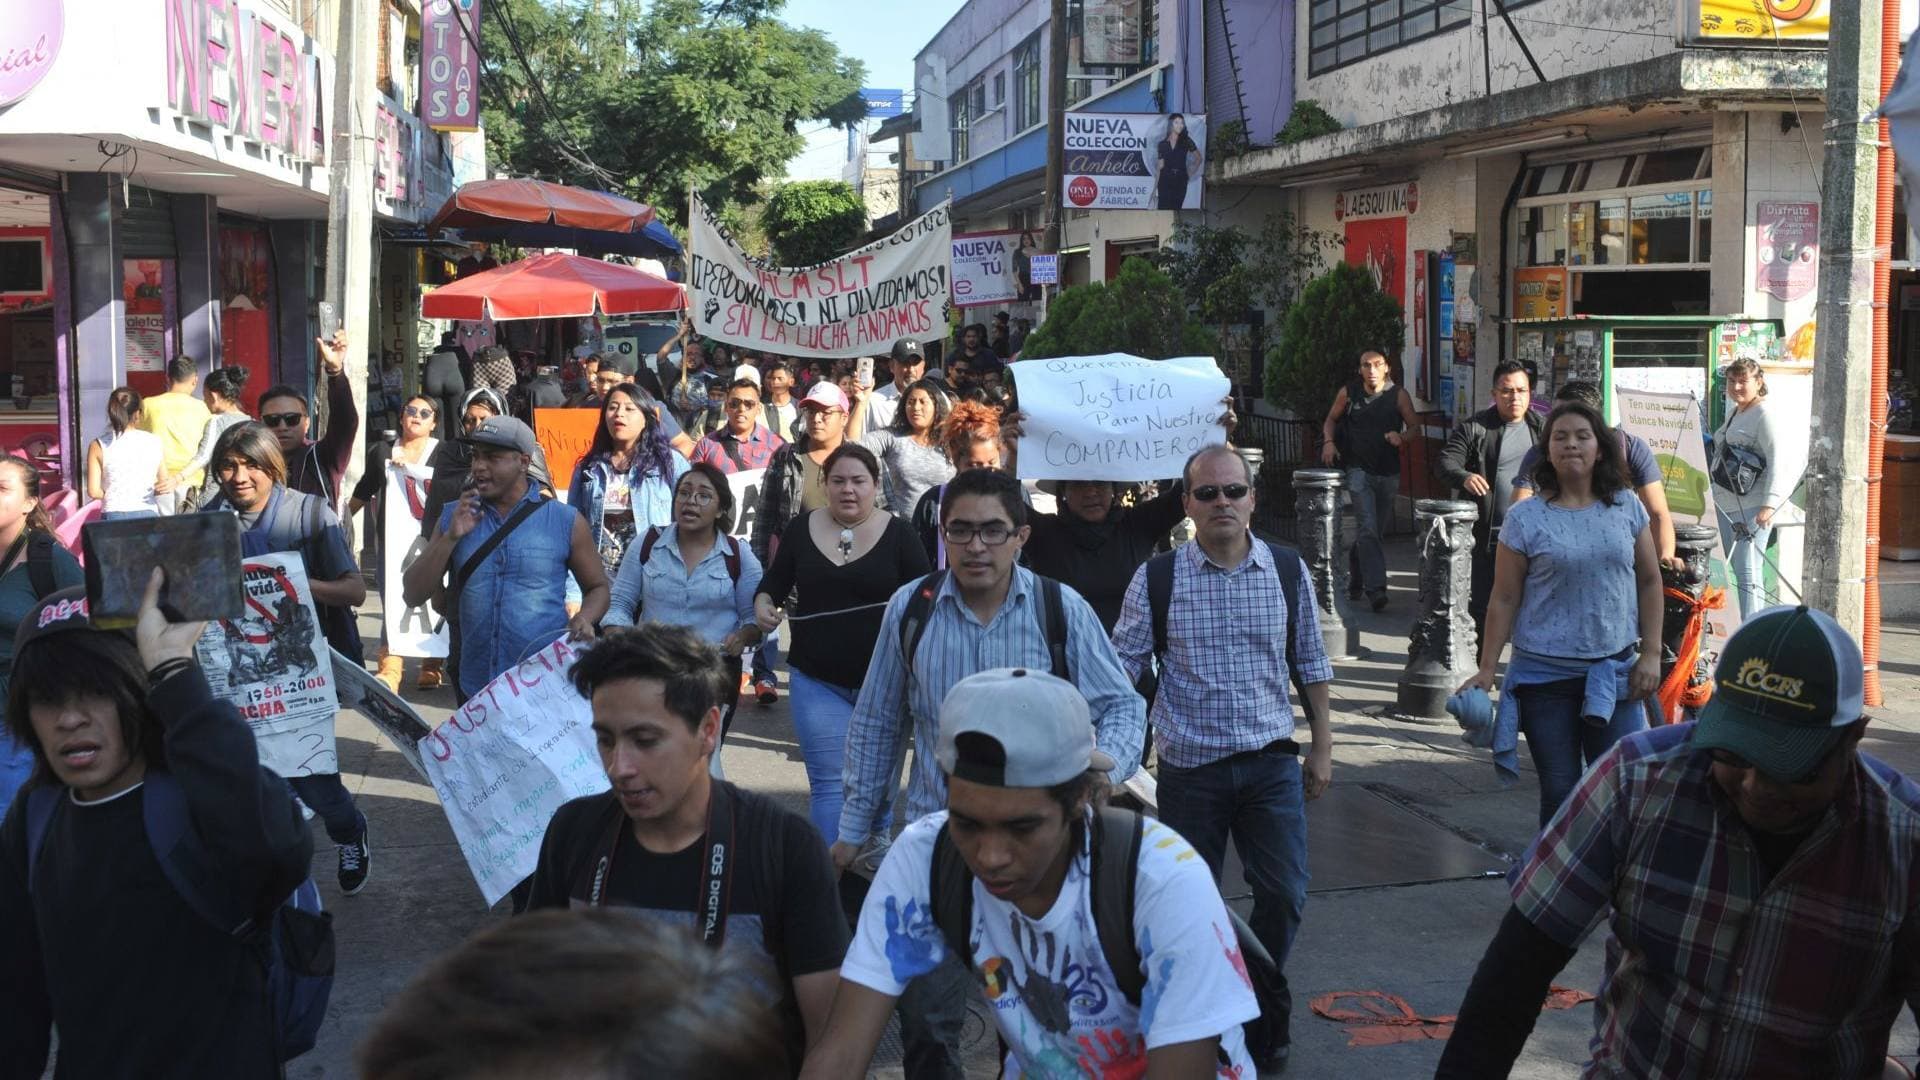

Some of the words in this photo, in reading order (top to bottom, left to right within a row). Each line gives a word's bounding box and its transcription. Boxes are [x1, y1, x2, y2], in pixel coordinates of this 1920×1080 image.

[0, 34, 47, 71] ial
[165, 0, 325, 166] NEVERIA
[1067, 118, 1133, 135] NUEVA
[1069, 151, 1142, 174] Anhelo
[1070, 186, 1096, 195] ONLY
[1101, 186, 1132, 195] TIENDA
[1136, 187, 1147, 195] DE
[1767, 205, 1809, 215] Disfruta
[953, 241, 1005, 257] NUEVA
[818, 256, 874, 297] SLT
[981, 257, 1001, 276] TÚ
[819, 296, 842, 325] NI
[848, 265, 946, 316] OLVIDAMOS!
[723, 304, 752, 336] EN
[761, 319, 787, 345] LA
[795, 321, 850, 350] LUCHA
[857, 300, 931, 345] ANDAMOS
[1071, 378, 1174, 409] Justicia
[1628, 398, 1644, 410] Ten
[1646, 401, 1660, 410] una
[1085, 410, 1139, 427] Para
[1146, 406, 1216, 432] Nuestro
[1658, 418, 1693, 430] Navidad
[247, 676, 326, 703] 1968-2008
[426, 640, 576, 762] JUSTICIA
[711, 843, 724, 876] EOS
[704, 880, 721, 941] DIGITAL
[1068, 963, 1108, 1015] 25
